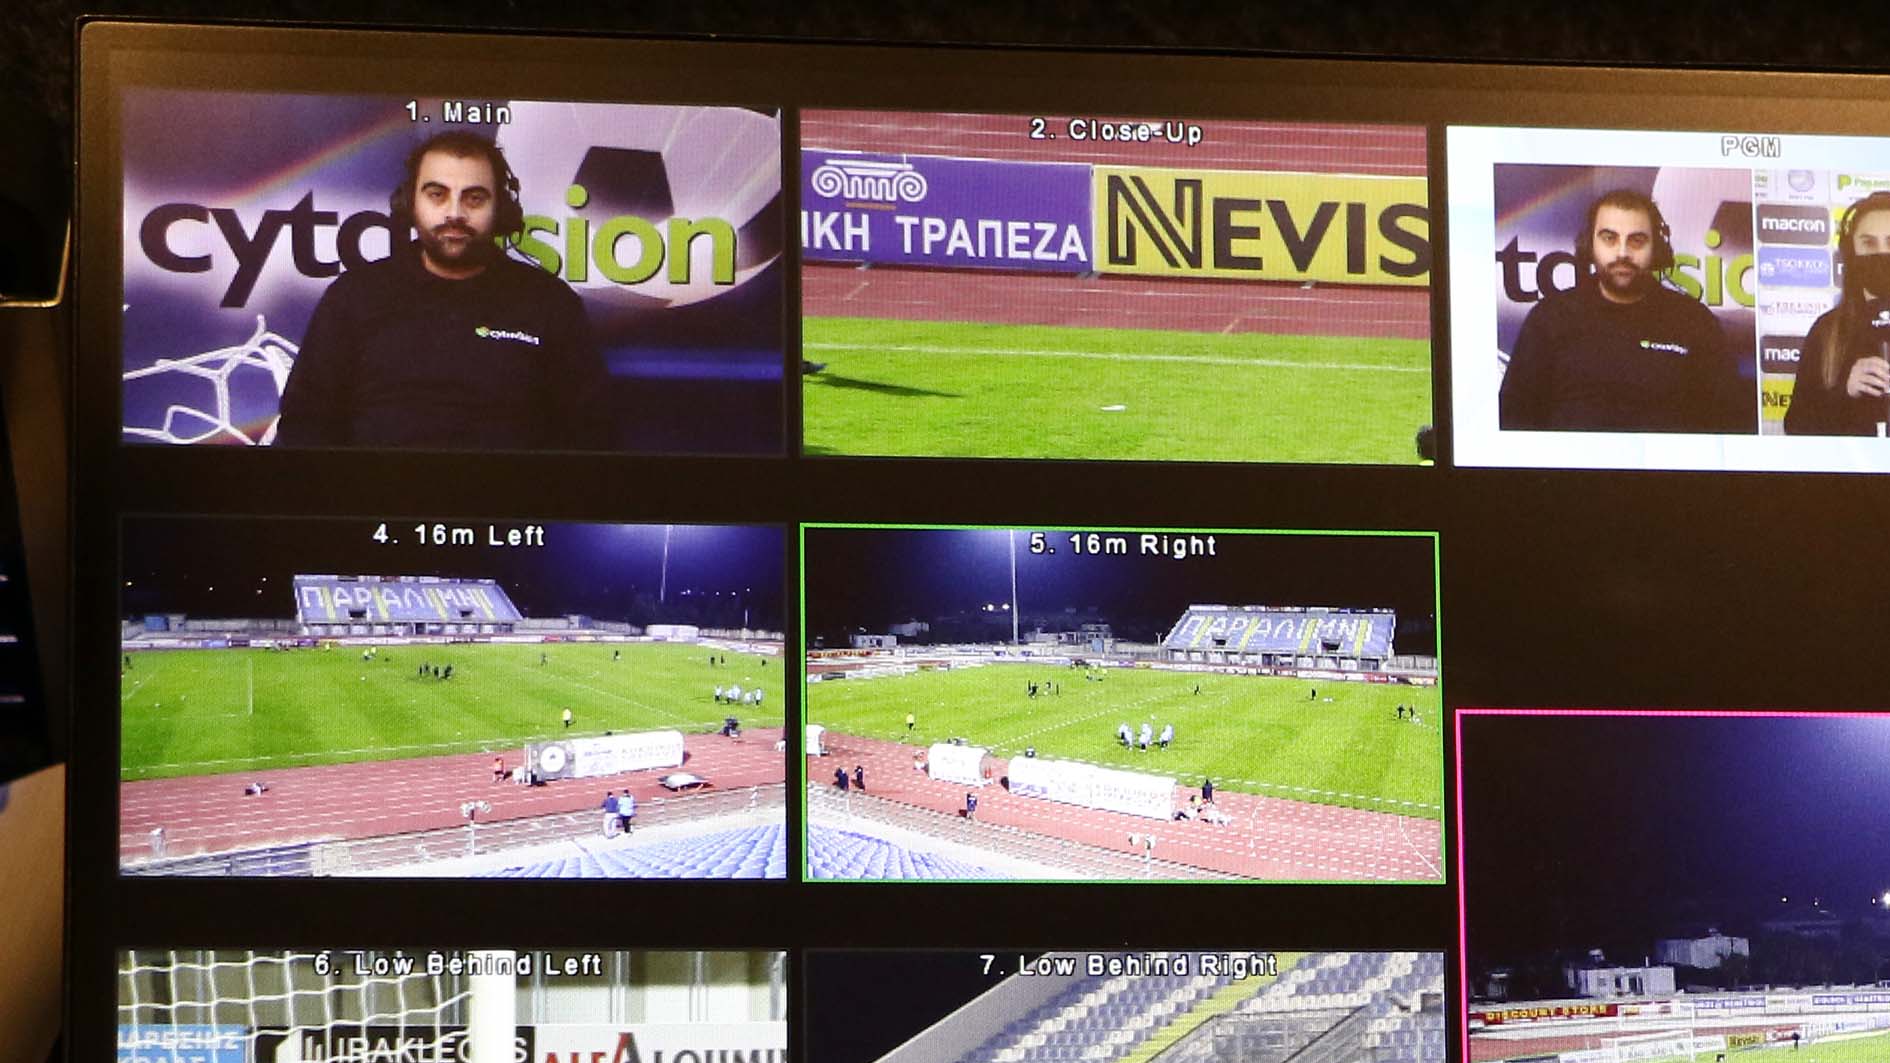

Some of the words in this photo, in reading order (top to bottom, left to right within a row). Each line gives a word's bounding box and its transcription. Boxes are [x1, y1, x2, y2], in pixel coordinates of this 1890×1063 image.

[406, 101, 431, 124] 1.
[443, 102, 511, 125] Main
[1031, 118, 1056, 141] 2.
[1069, 119, 1202, 146] Close-Up
[1721, 135, 1782, 159] PGM
[895, 215, 1089, 263] ΤΡΑΠΕΖΑ
[373, 524, 399, 544] 4.
[415, 524, 475, 545] 16m
[489, 526, 545, 546] Left
[1030, 533, 1056, 554] 5.
[1071, 534, 1128, 555] 16m
[1141, 534, 1217, 559] Right
[315, 953, 341, 976] 6.
[355, 953, 415, 976] Low
[428, 952, 531, 976] Behind
[545, 953, 602, 976] Left
[980, 955, 1005, 976] 7.
[1020, 955, 1076, 977] Low
[1087, 954, 1190, 977] Behind
[1200, 954, 1278, 980] Right
